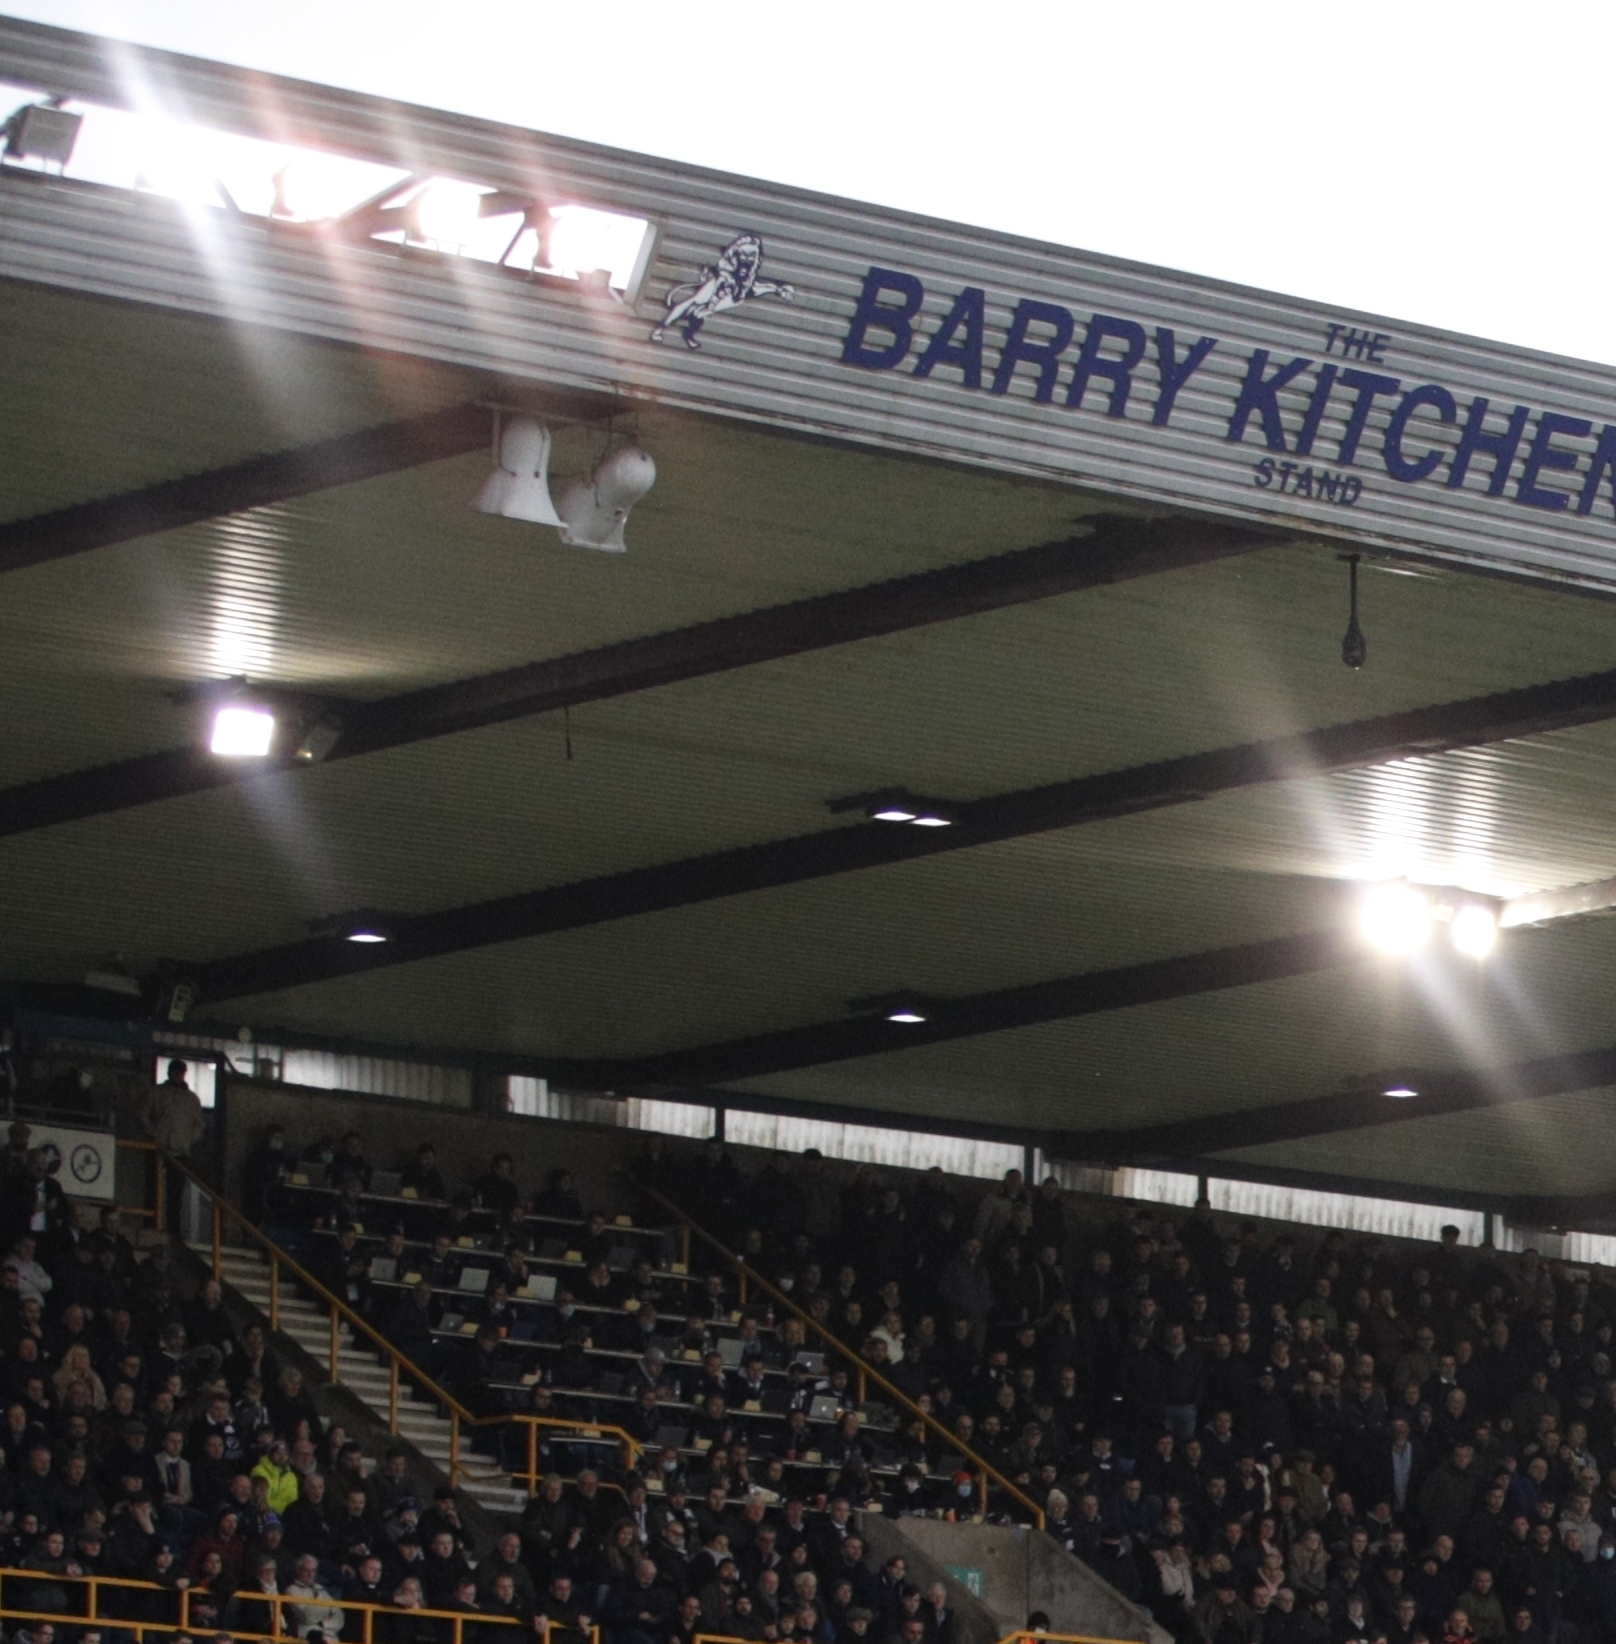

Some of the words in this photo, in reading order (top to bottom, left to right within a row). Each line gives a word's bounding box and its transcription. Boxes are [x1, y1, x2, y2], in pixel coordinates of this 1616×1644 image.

[841, 266, 1217, 428] BARRY
[1325, 322, 1391, 367] THE
[1252, 457, 1362, 507] STAND
